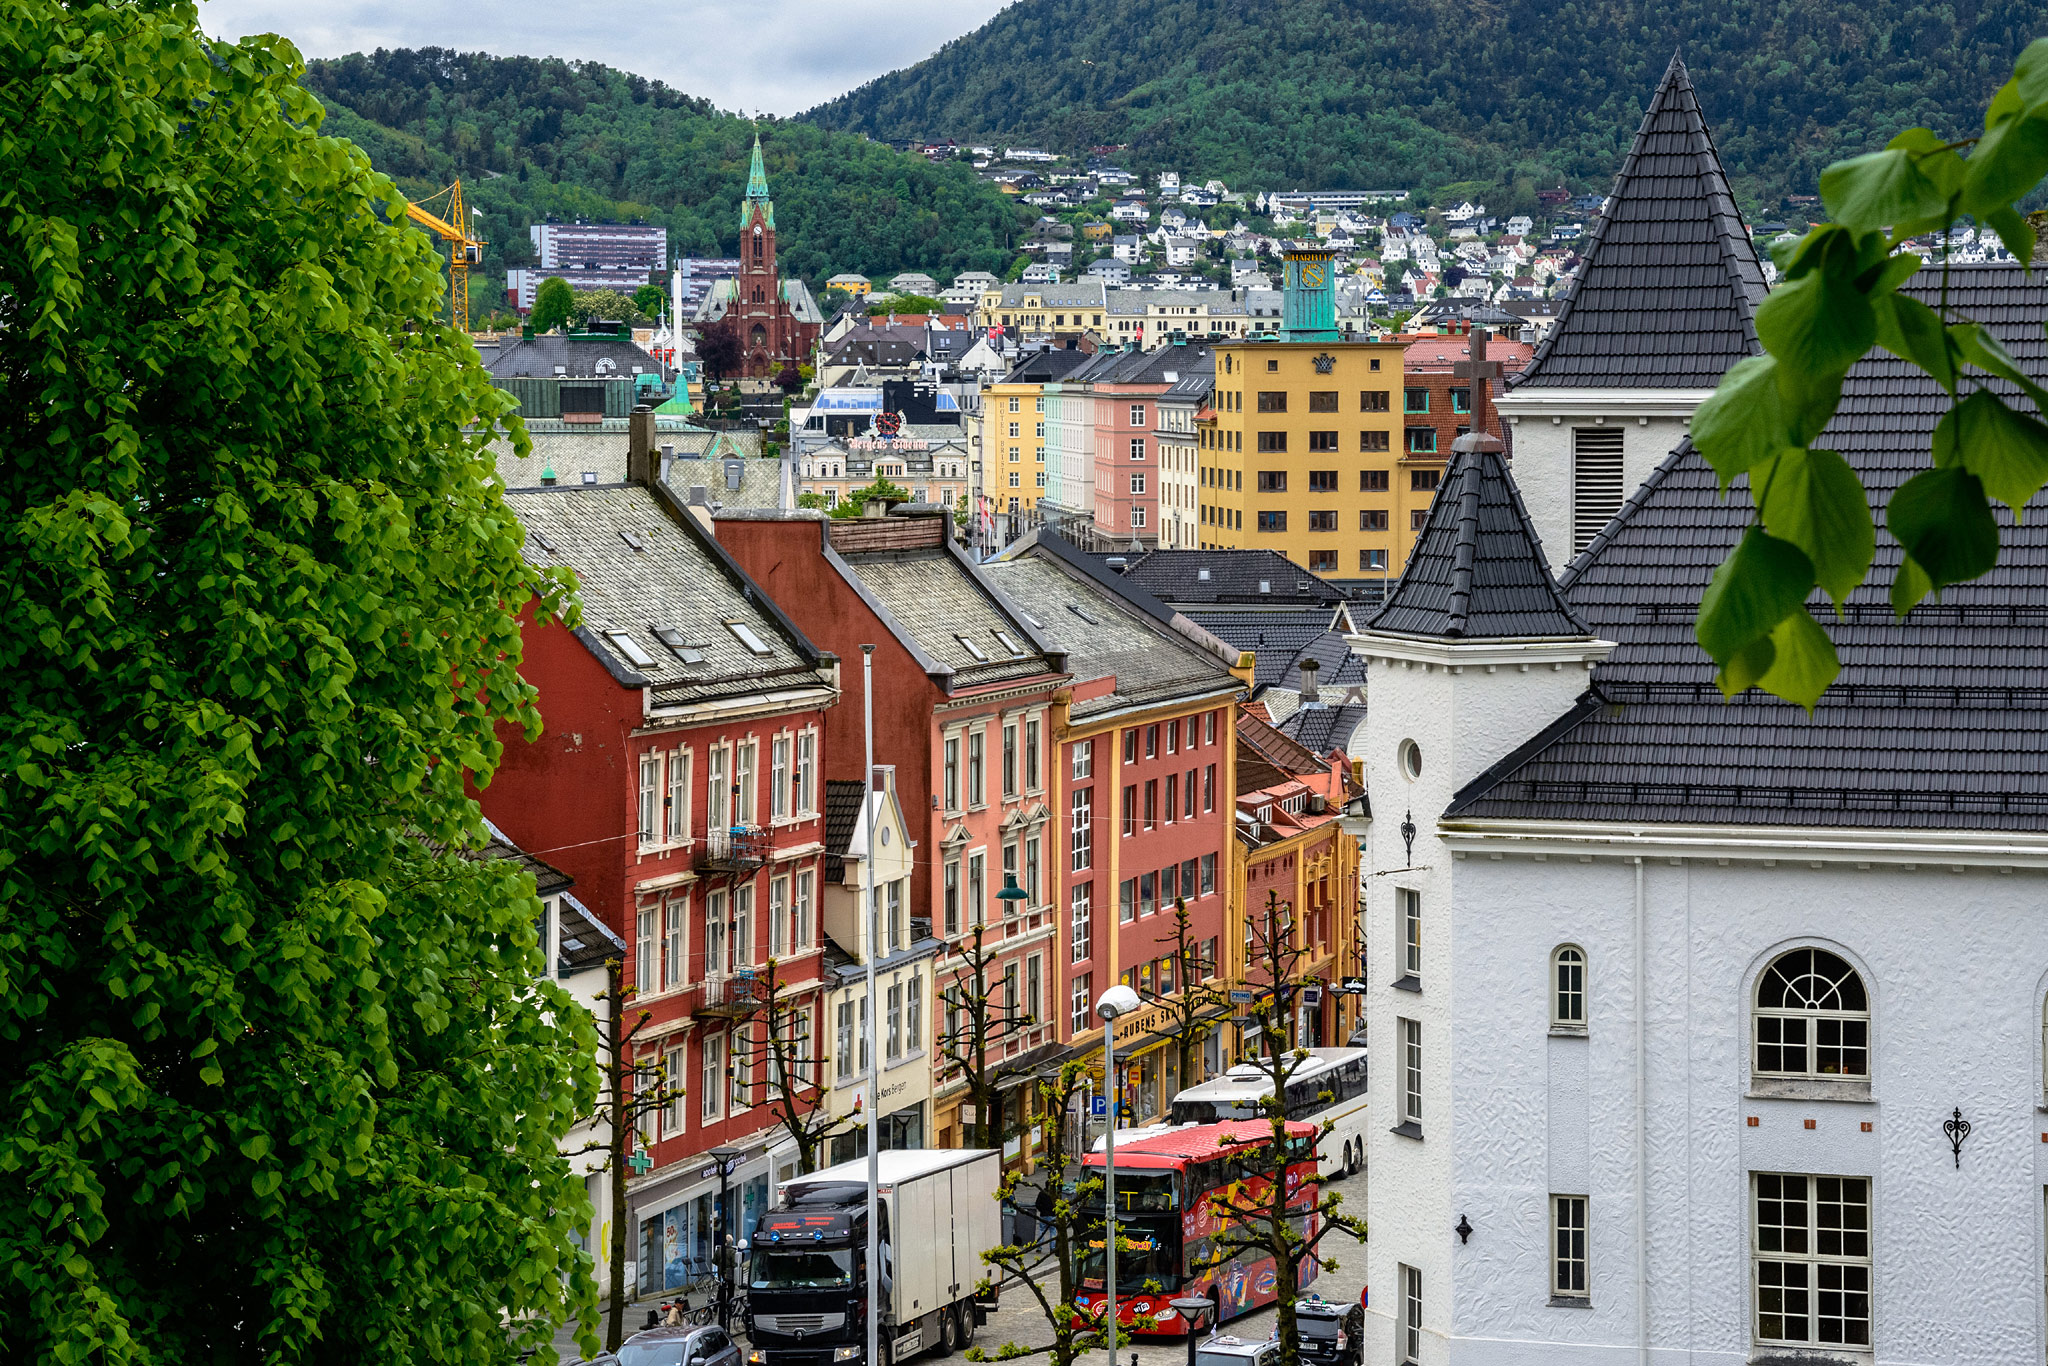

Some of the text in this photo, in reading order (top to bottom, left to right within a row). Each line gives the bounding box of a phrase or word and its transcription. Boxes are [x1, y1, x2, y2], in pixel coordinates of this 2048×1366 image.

[847, 437, 929, 451] Bergens Tidende
[1124, 1014, 1155, 1039] RUBENS
[881, 1087, 892, 1099] Kors
[891, 1081, 907, 1095] Bergen
[1096, 1098, 1106, 1112] P
